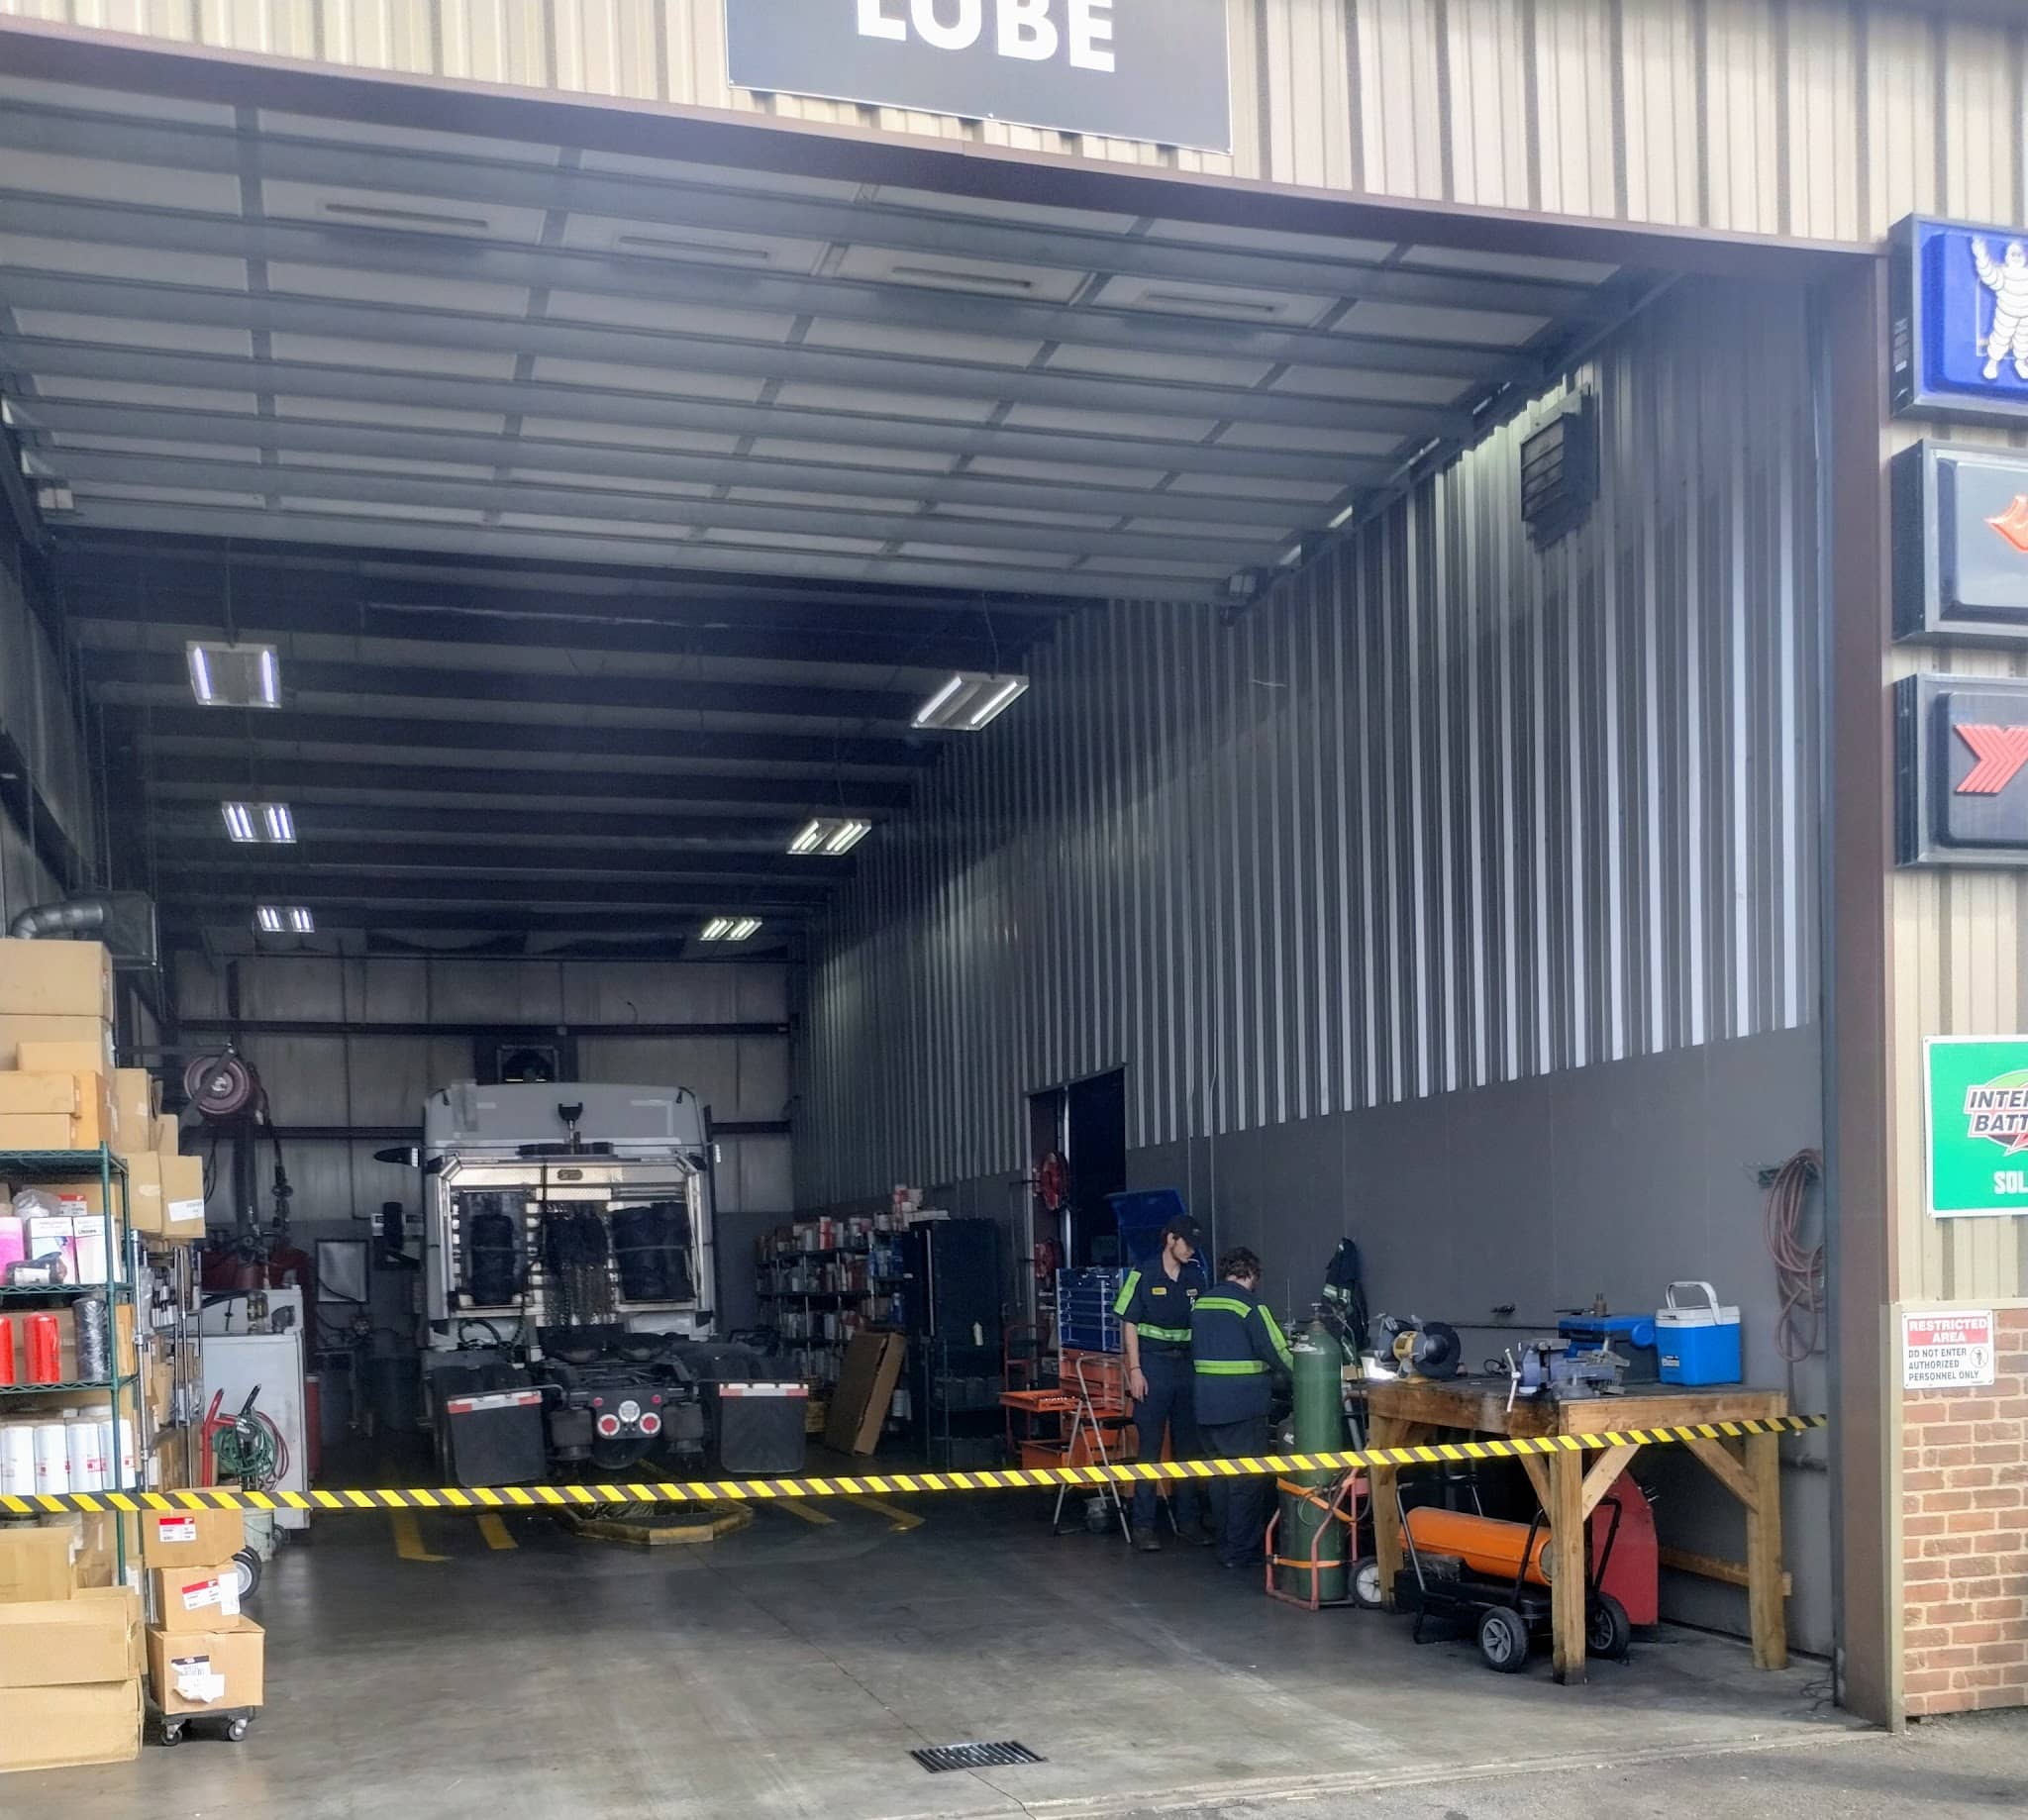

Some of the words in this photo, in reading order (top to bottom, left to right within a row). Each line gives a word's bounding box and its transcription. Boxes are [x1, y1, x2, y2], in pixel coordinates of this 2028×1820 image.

[1970, 1090, 2028, 1108] INTE
[1908, 1318, 1987, 1332] RESTRICTED
[1932, 1331, 1966, 1344] AREA
[1908, 1350, 1920, 1359] DO
[1922, 1349, 1938, 1358] NOT
[1941, 1348, 1967, 1357] ENTER
[1908, 1360, 1960, 1369] AUTHORIZED
[1908, 1371, 1957, 1381] PERSONNEL
[1959, 1370, 1979, 1379] ONLY
